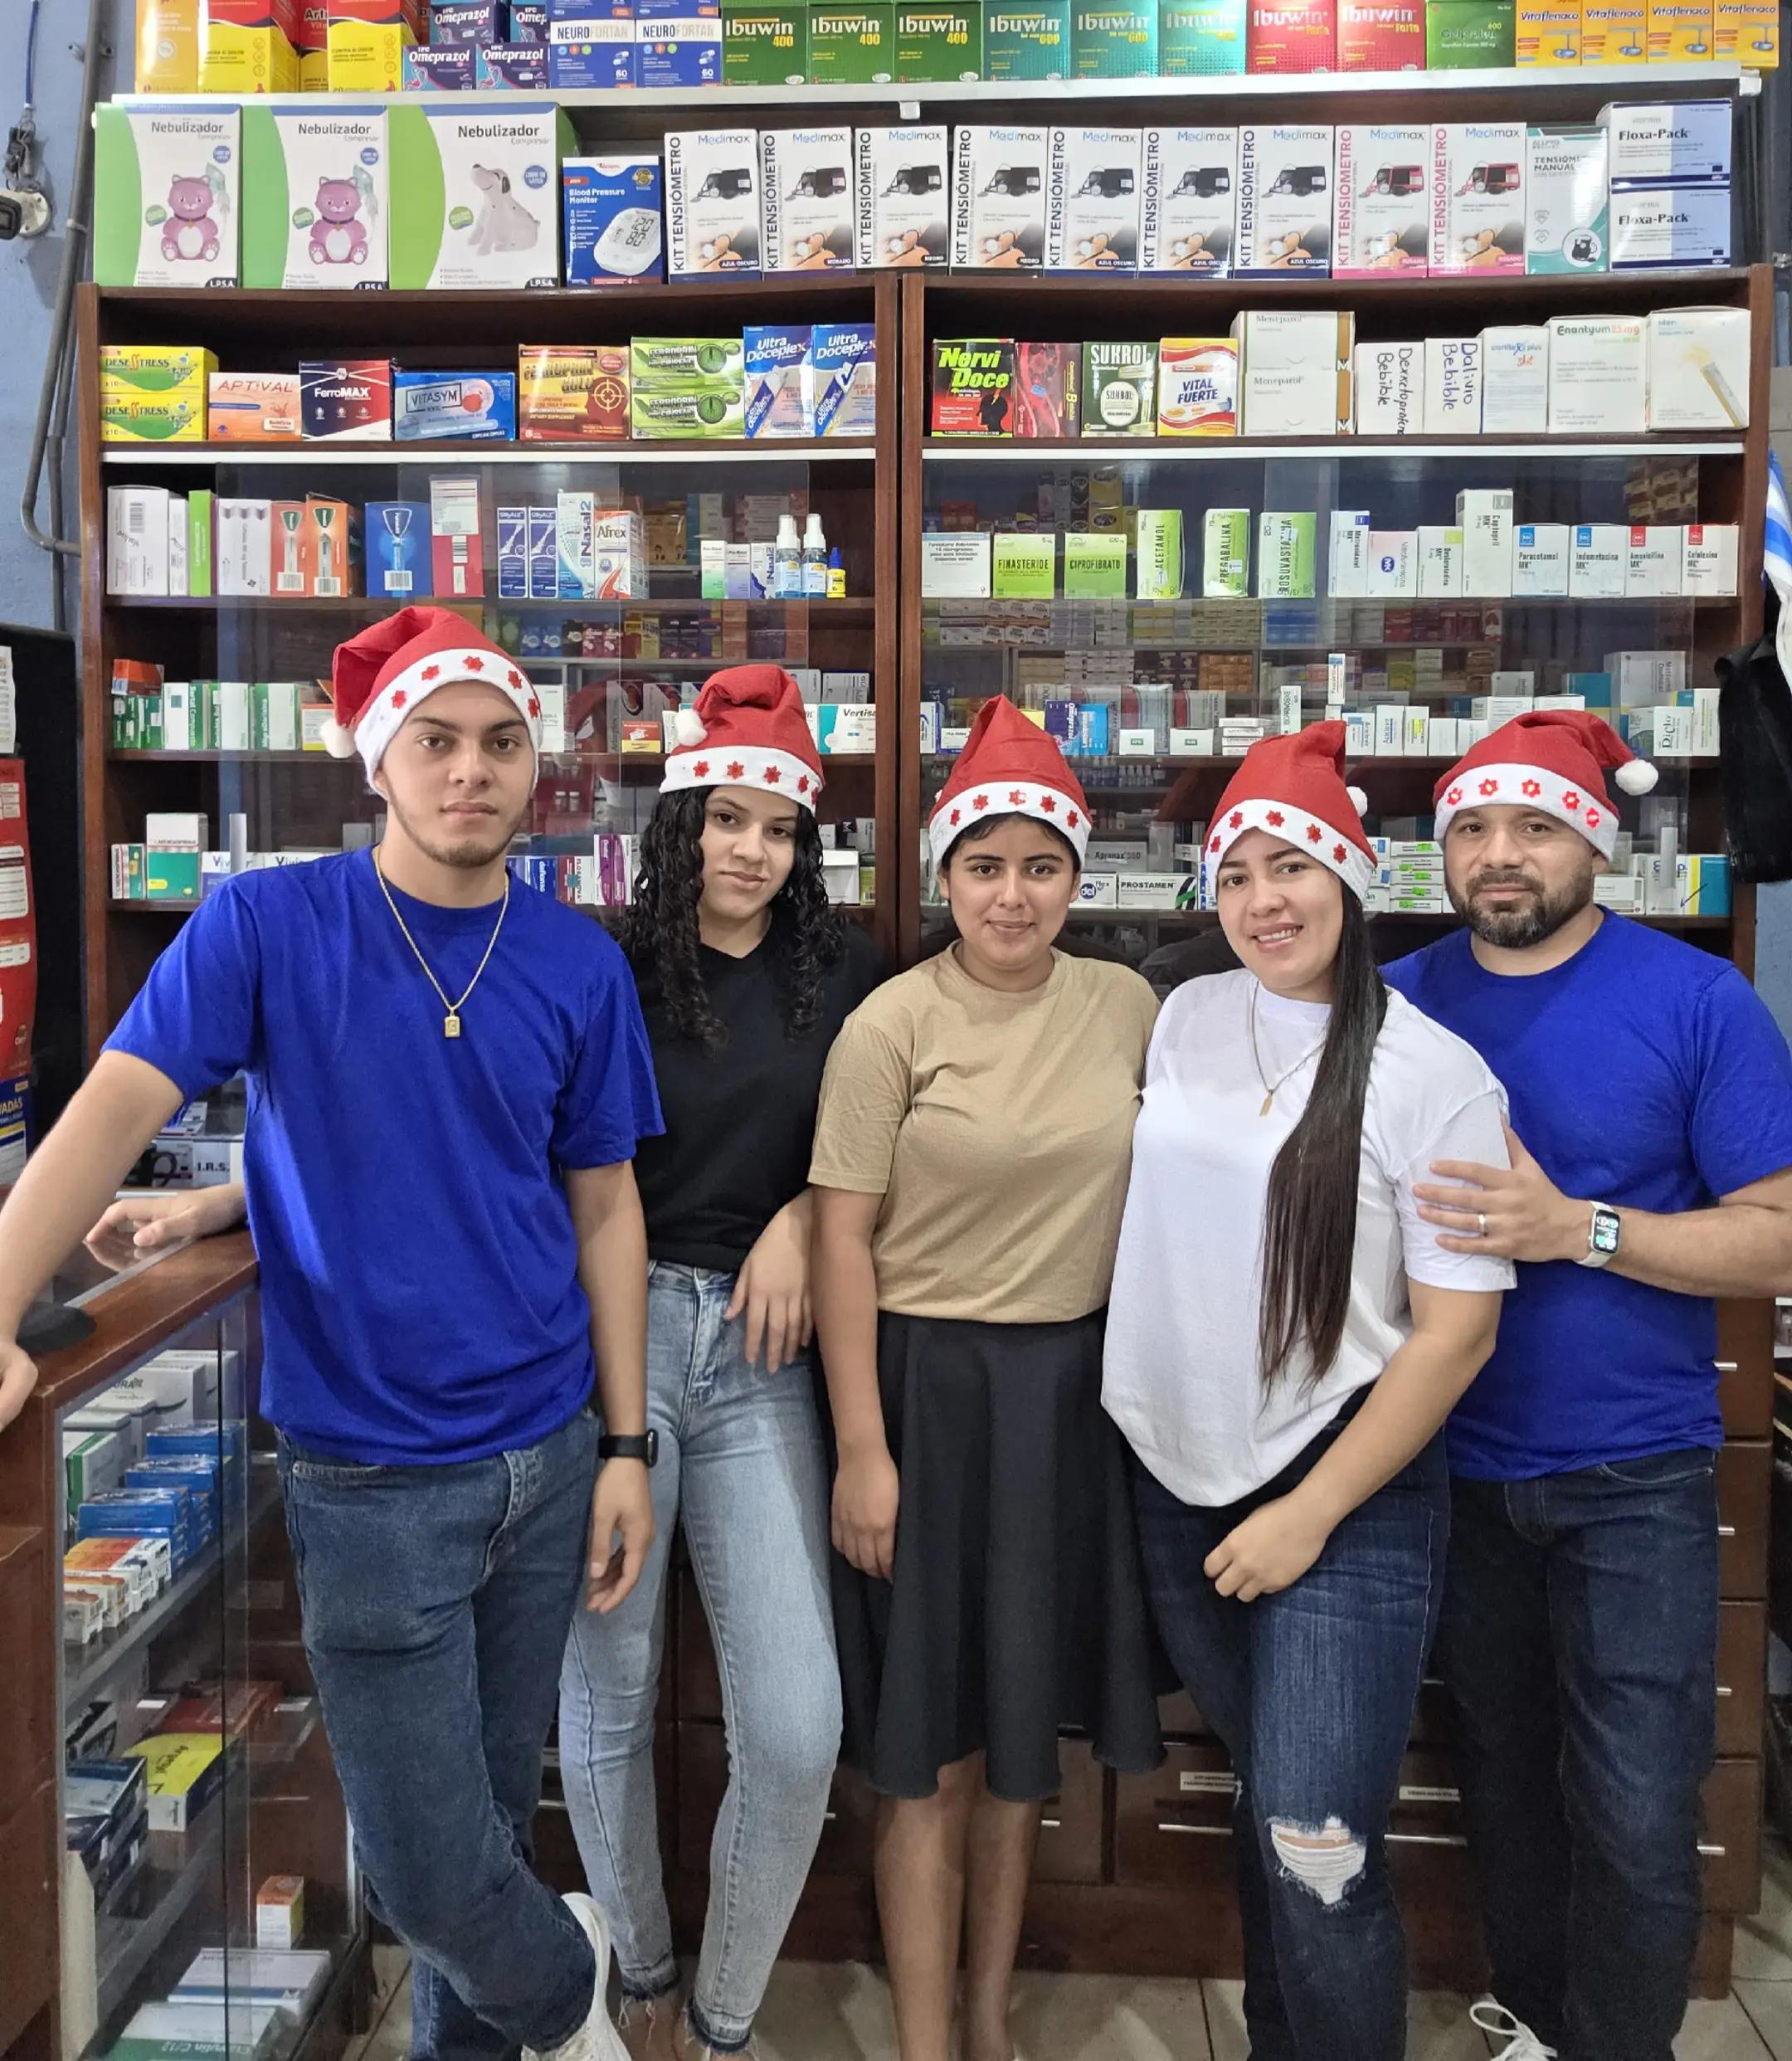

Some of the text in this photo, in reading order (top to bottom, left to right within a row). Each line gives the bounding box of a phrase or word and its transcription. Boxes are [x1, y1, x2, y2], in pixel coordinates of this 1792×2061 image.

[435, 7, 490, 26] Omeprazol
[516, 11, 547, 25] Omep
[1254, 8, 1325, 27] Ibuwin
[1341, 5, 1414, 23] Ibuwin
[726, 18, 794, 37] Ibuwin
[812, 17, 879, 34] Ibuwin
[899, 17, 967, 34] Ibuwin
[990, 15, 1060, 32] Ibuwin
[1079, 13, 1149, 31] Ibuwin
[558, 25, 629, 40] NEUROFORTAN
[643, 24, 714, 39] NEUROFORTAN
[947, 32, 968, 44] 400
[772, 36, 794, 47] 400
[859, 33, 880, 45] 400
[1040, 33, 1060, 45] 600
[409, 49, 470, 65] Omeprazol
[482, 48, 544, 64] Omeprazol
[151, 120, 224, 134] Nebulizador
[299, 122, 372, 134] Nebulizador
[458, 124, 540, 138] Nebulizador
[1465, 127, 1520, 139] Medimax
[510, 137, 550, 145] Compresor
[698, 134, 750, 144] Medimax
[792, 133, 845, 143] Medimax
[889, 131, 942, 141] Medimax
[989, 130, 1041, 142] Medimax
[1083, 131, 1136, 142] Medimax
[1178, 131, 1231, 142] Medimax
[1273, 129, 1327, 140] Medimax
[1370, 129, 1424, 140] Medimax
[1619, 129, 1690, 142] Floxa-Pack
[1534, 164, 1575, 173] MANUAL
[569, 188, 626, 197] Blood Pressure
[569, 197, 598, 206] Monitor
[1619, 212, 1690, 226] Floxa-Pack
[674, 249, 684, 270] KIT
[767, 247, 778, 269] KIT
[860, 244, 871, 265] KIT
[955, 241, 968, 265] KIT
[1049, 242, 1061, 266] KIT
[1143, 243, 1156, 267] KIT
[1240, 242, 1252, 266] KIT
[1338, 241, 1350, 266] KIT
[1434, 241, 1445, 266] KIT
[1557, 325, 1611, 336] Enantyum
[757, 334, 787, 350] Ultra
[828, 334, 858, 347] Ultra
[747, 344, 806, 363] Doceplex
[938, 347, 1001, 368] Nervi
[1090, 344, 1151, 365] SUKROL
[951, 368, 1010, 389] Doce
[1442, 344, 1460, 412] Bebible
[1460, 343, 1478, 405] Dalivio
[218, 380, 293, 393] APTIVAL
[1181, 378, 1214, 392] VITAL
[314, 387, 370, 398] FerroMAX
[411, 389, 458, 405] VITASYM
[1177, 389, 1218, 405] FUERTE
[597, 524, 626, 538] Afrex
[1492, 514, 1501, 547] Captopril
[1155, 524, 1166, 570] ACETAMOL
[1220, 523, 1233, 584] PREGABALINA
[1518, 552, 1559, 561] Paracetamol
[1575, 552, 1619, 561] Indometacina
[998, 558, 1049, 570] FINASTERIDE
[1069, 559, 1121, 570] CIPROFIBRATO
[1094, 851, 1124, 860] Apranax
[1121, 881, 1173, 889] PROSTAMEN
